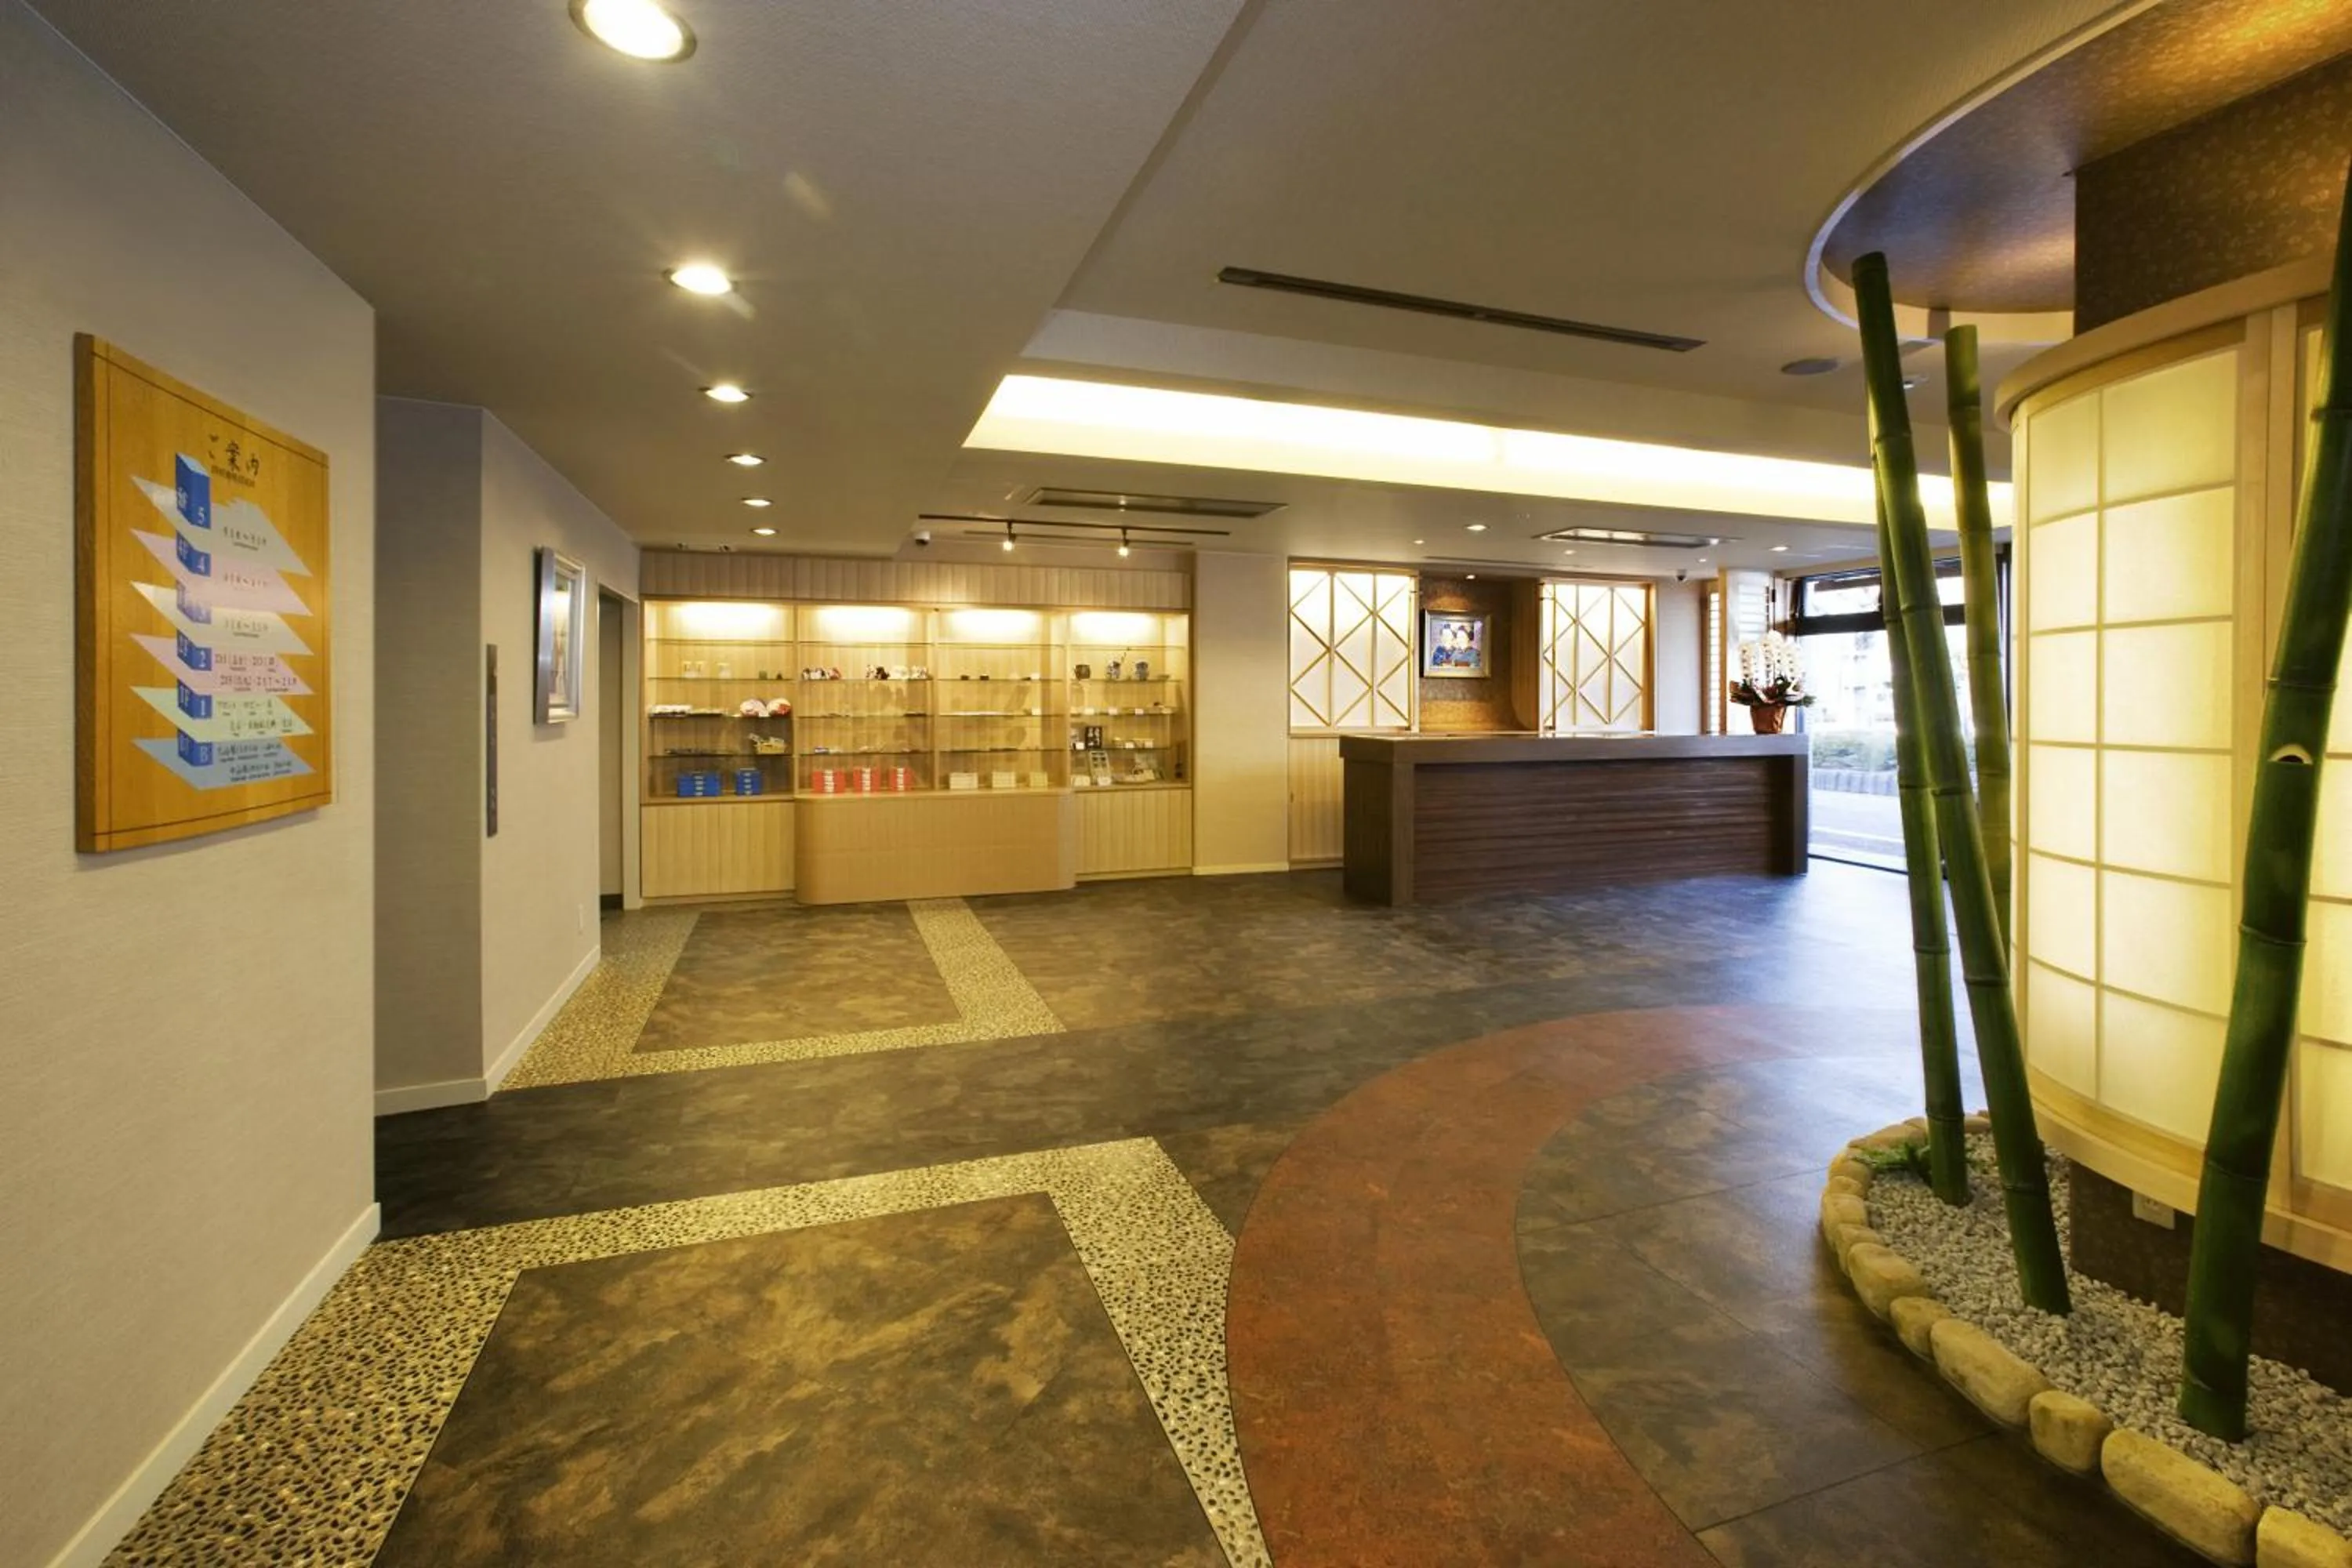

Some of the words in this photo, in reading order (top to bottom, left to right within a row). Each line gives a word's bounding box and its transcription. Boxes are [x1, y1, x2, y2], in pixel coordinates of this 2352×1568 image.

[198, 506, 205, 524] 5
[197, 554, 205, 573] 4
[198, 650, 206, 668] 2
[200, 699, 206, 717] 1
